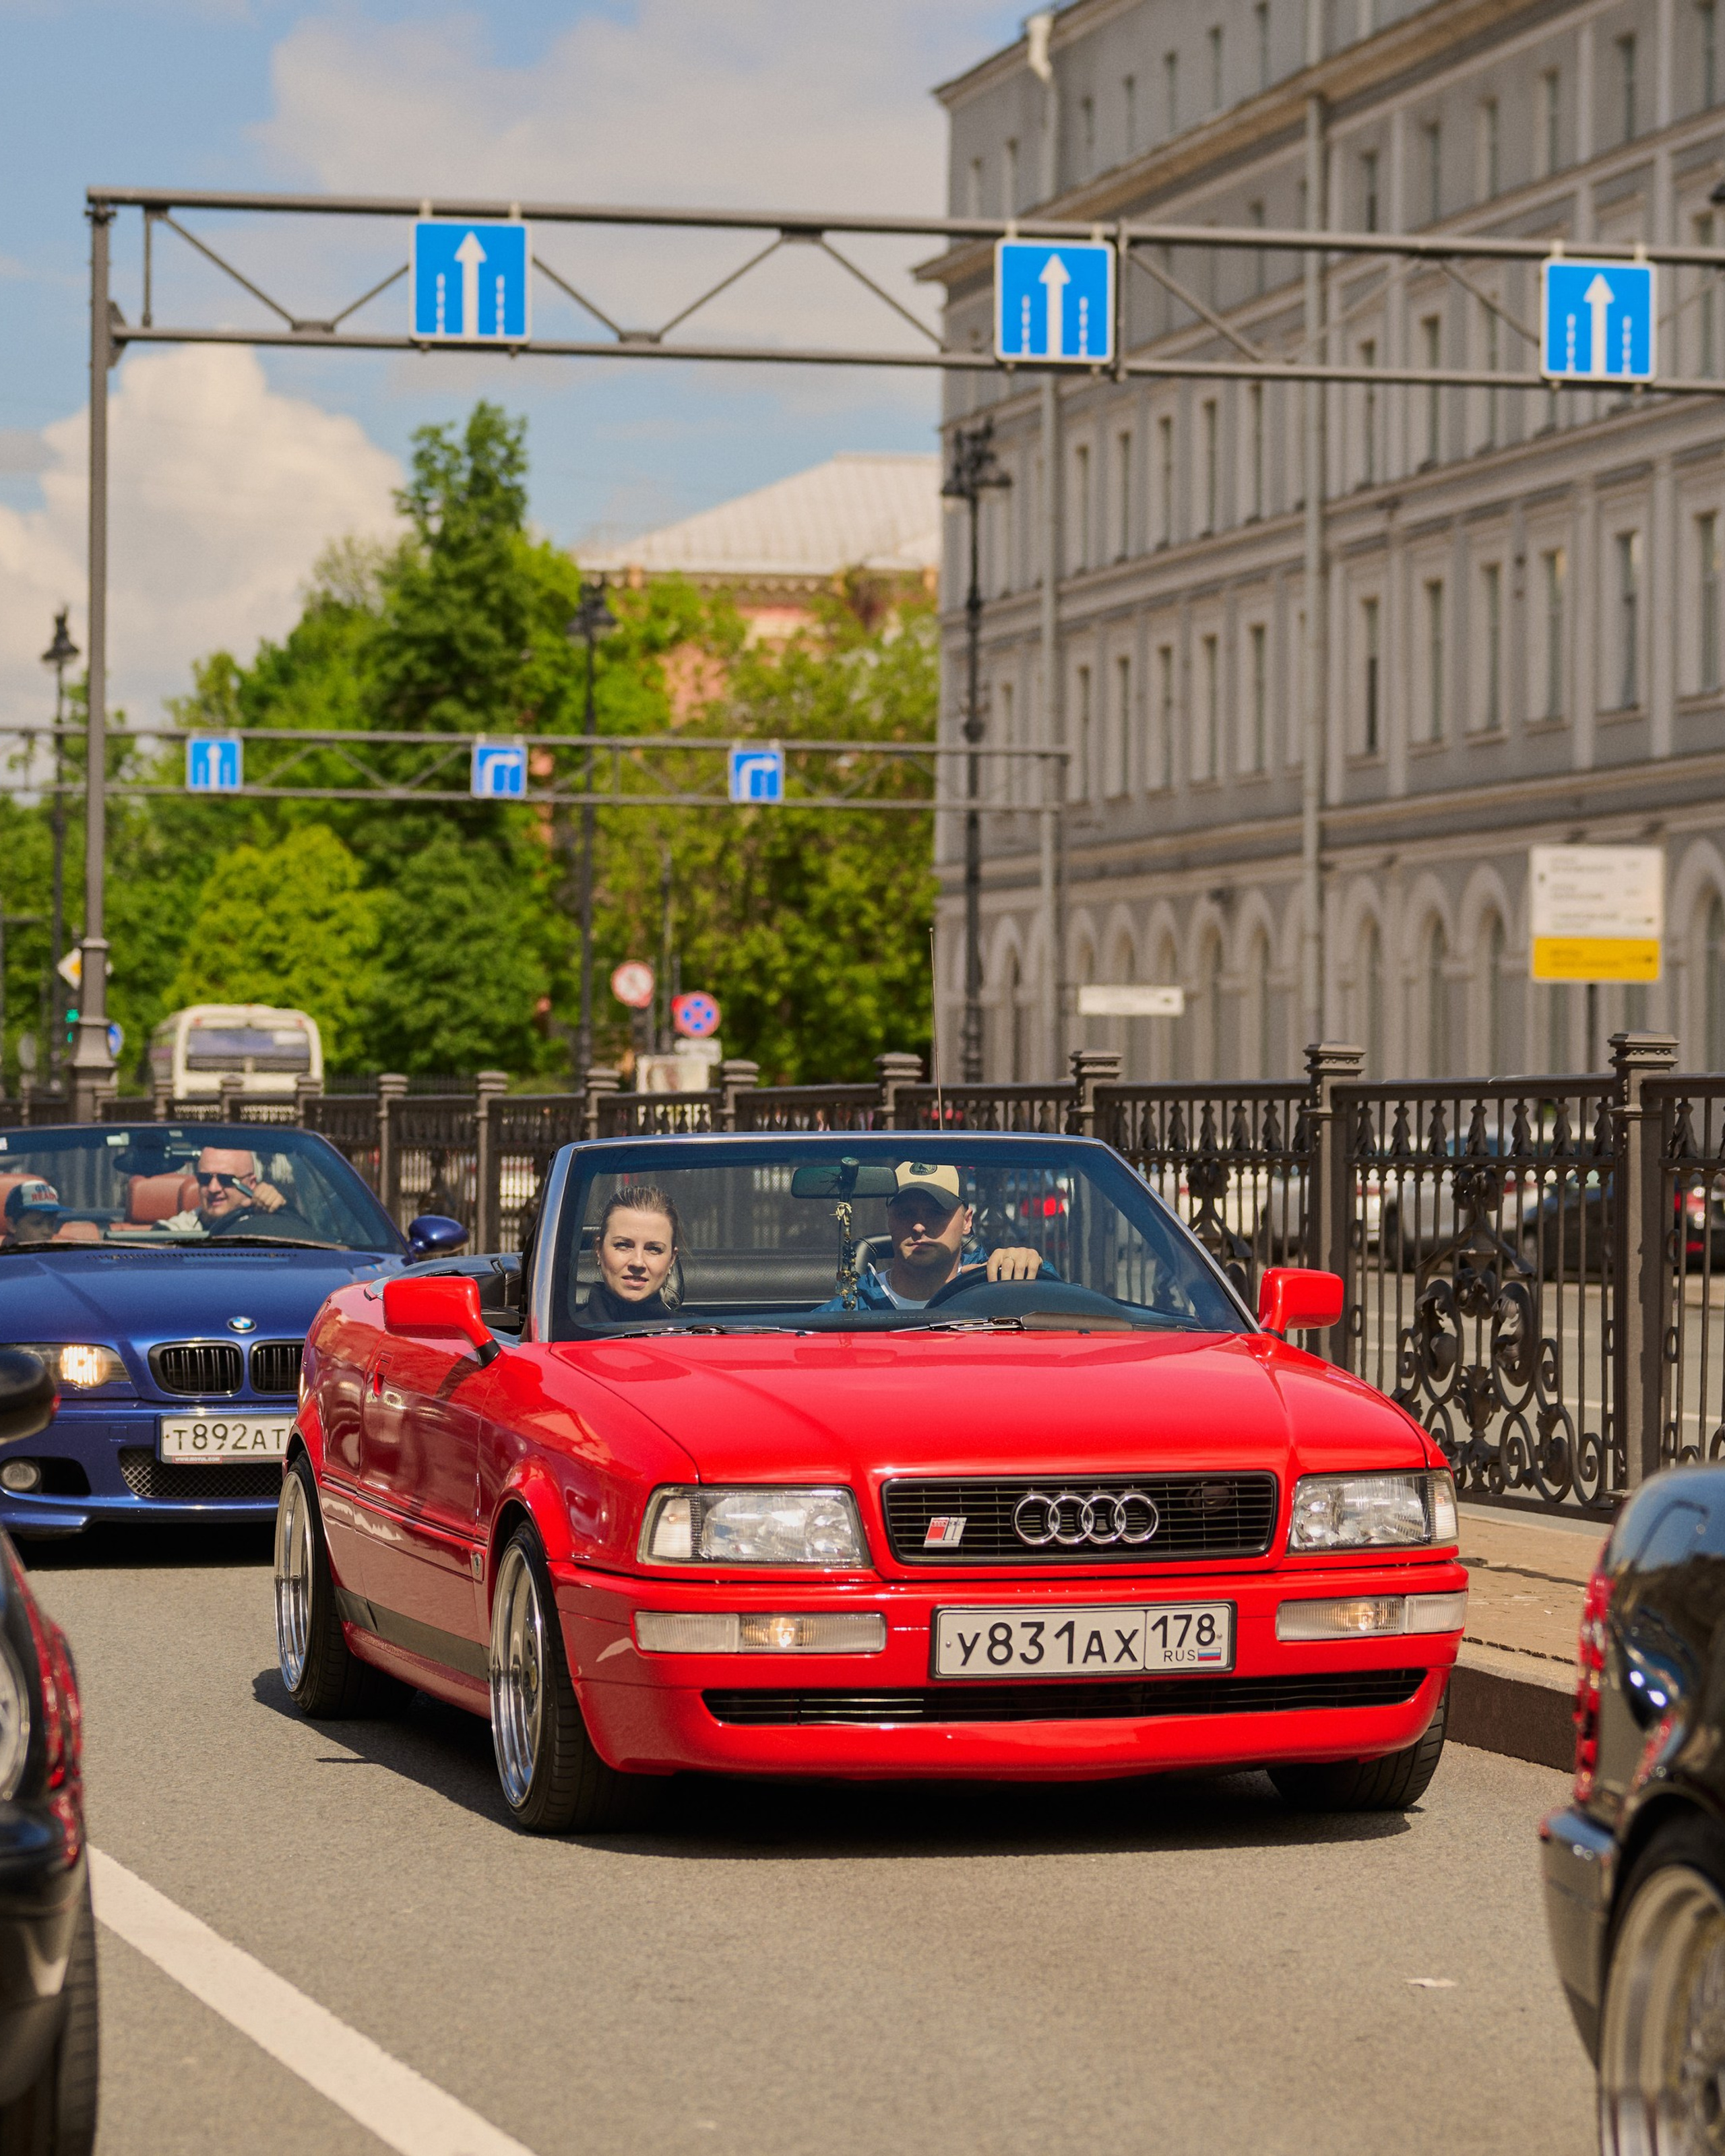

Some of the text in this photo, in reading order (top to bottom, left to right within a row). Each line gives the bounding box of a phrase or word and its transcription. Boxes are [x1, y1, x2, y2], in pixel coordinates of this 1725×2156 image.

[172, 1423, 286, 1451] Т892АТ
[957, 1613, 1216, 1667] У831АХ 178
[1164, 1649, 1196, 1663] RUS
